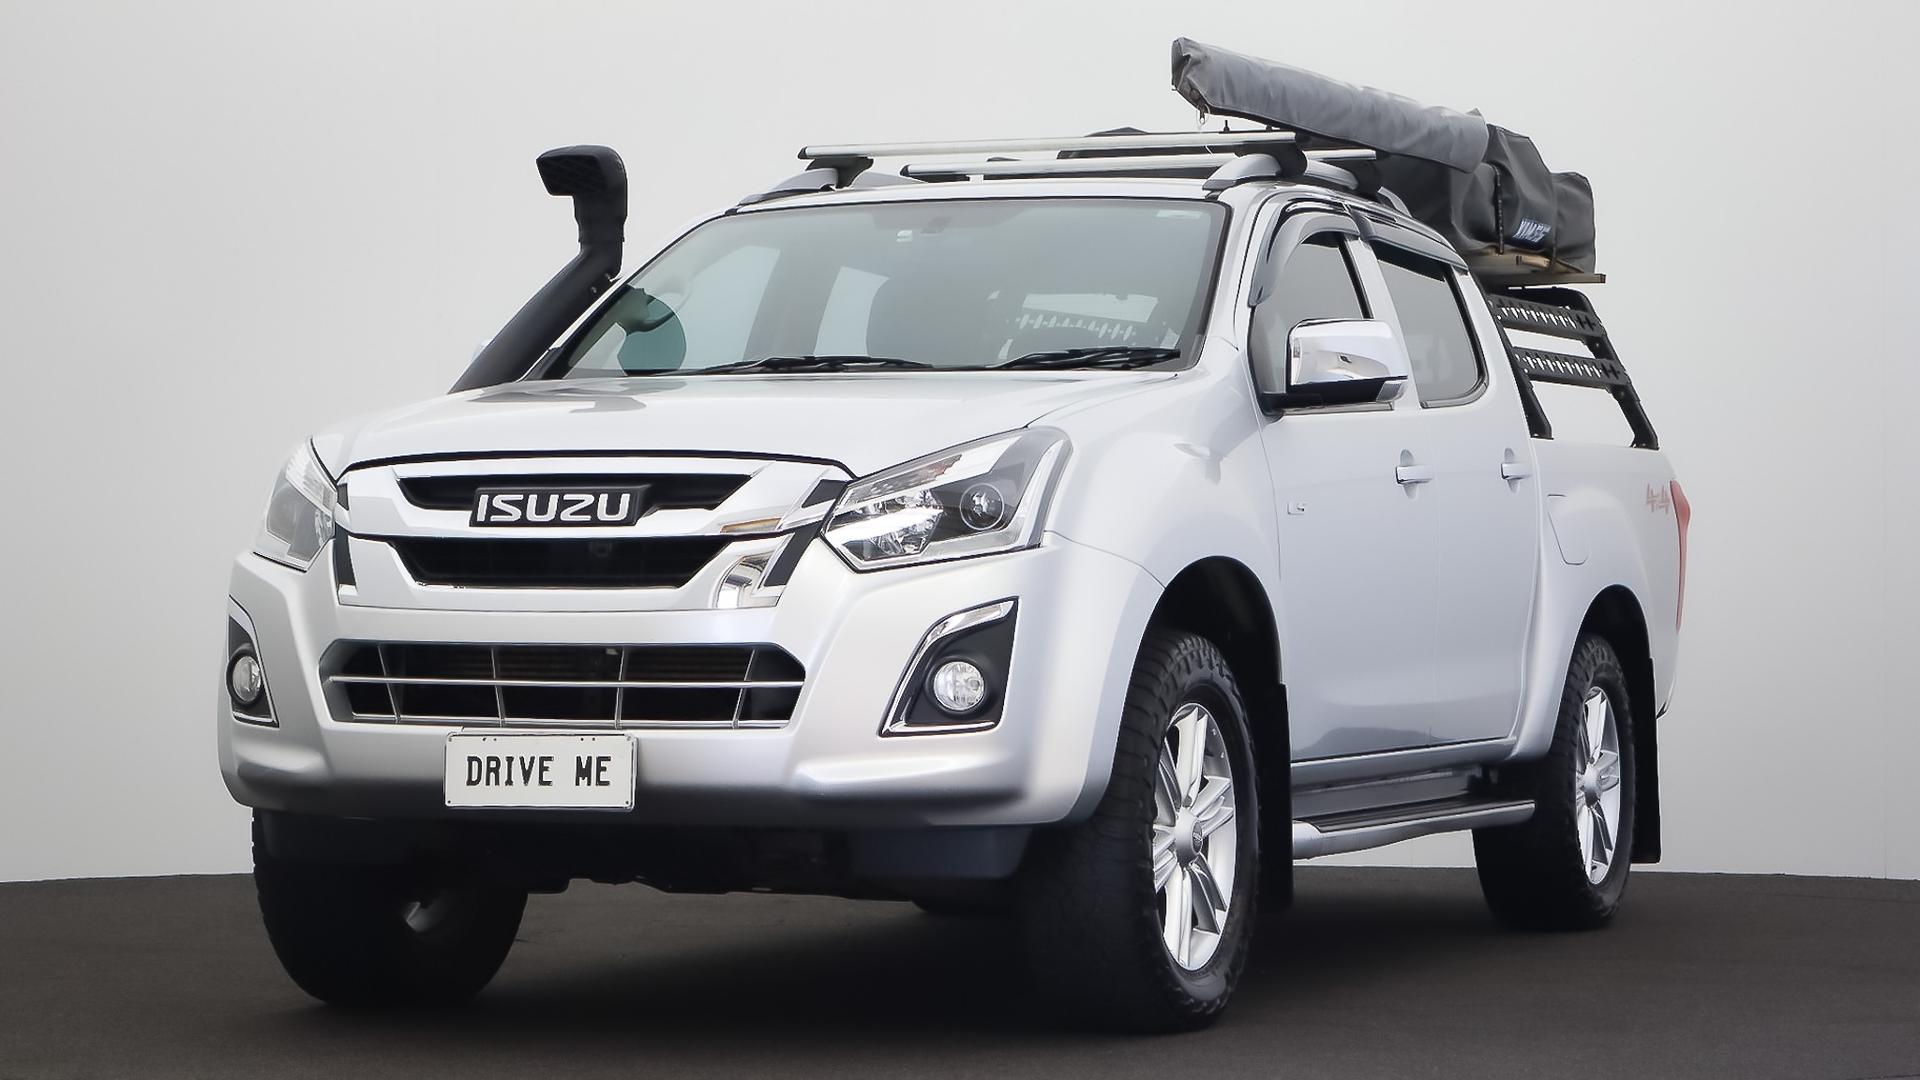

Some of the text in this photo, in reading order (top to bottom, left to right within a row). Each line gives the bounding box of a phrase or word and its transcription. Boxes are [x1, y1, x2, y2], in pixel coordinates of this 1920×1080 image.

[476, 493, 631, 522] ISUZU
[466, 756, 612, 787] DRIVE ME
